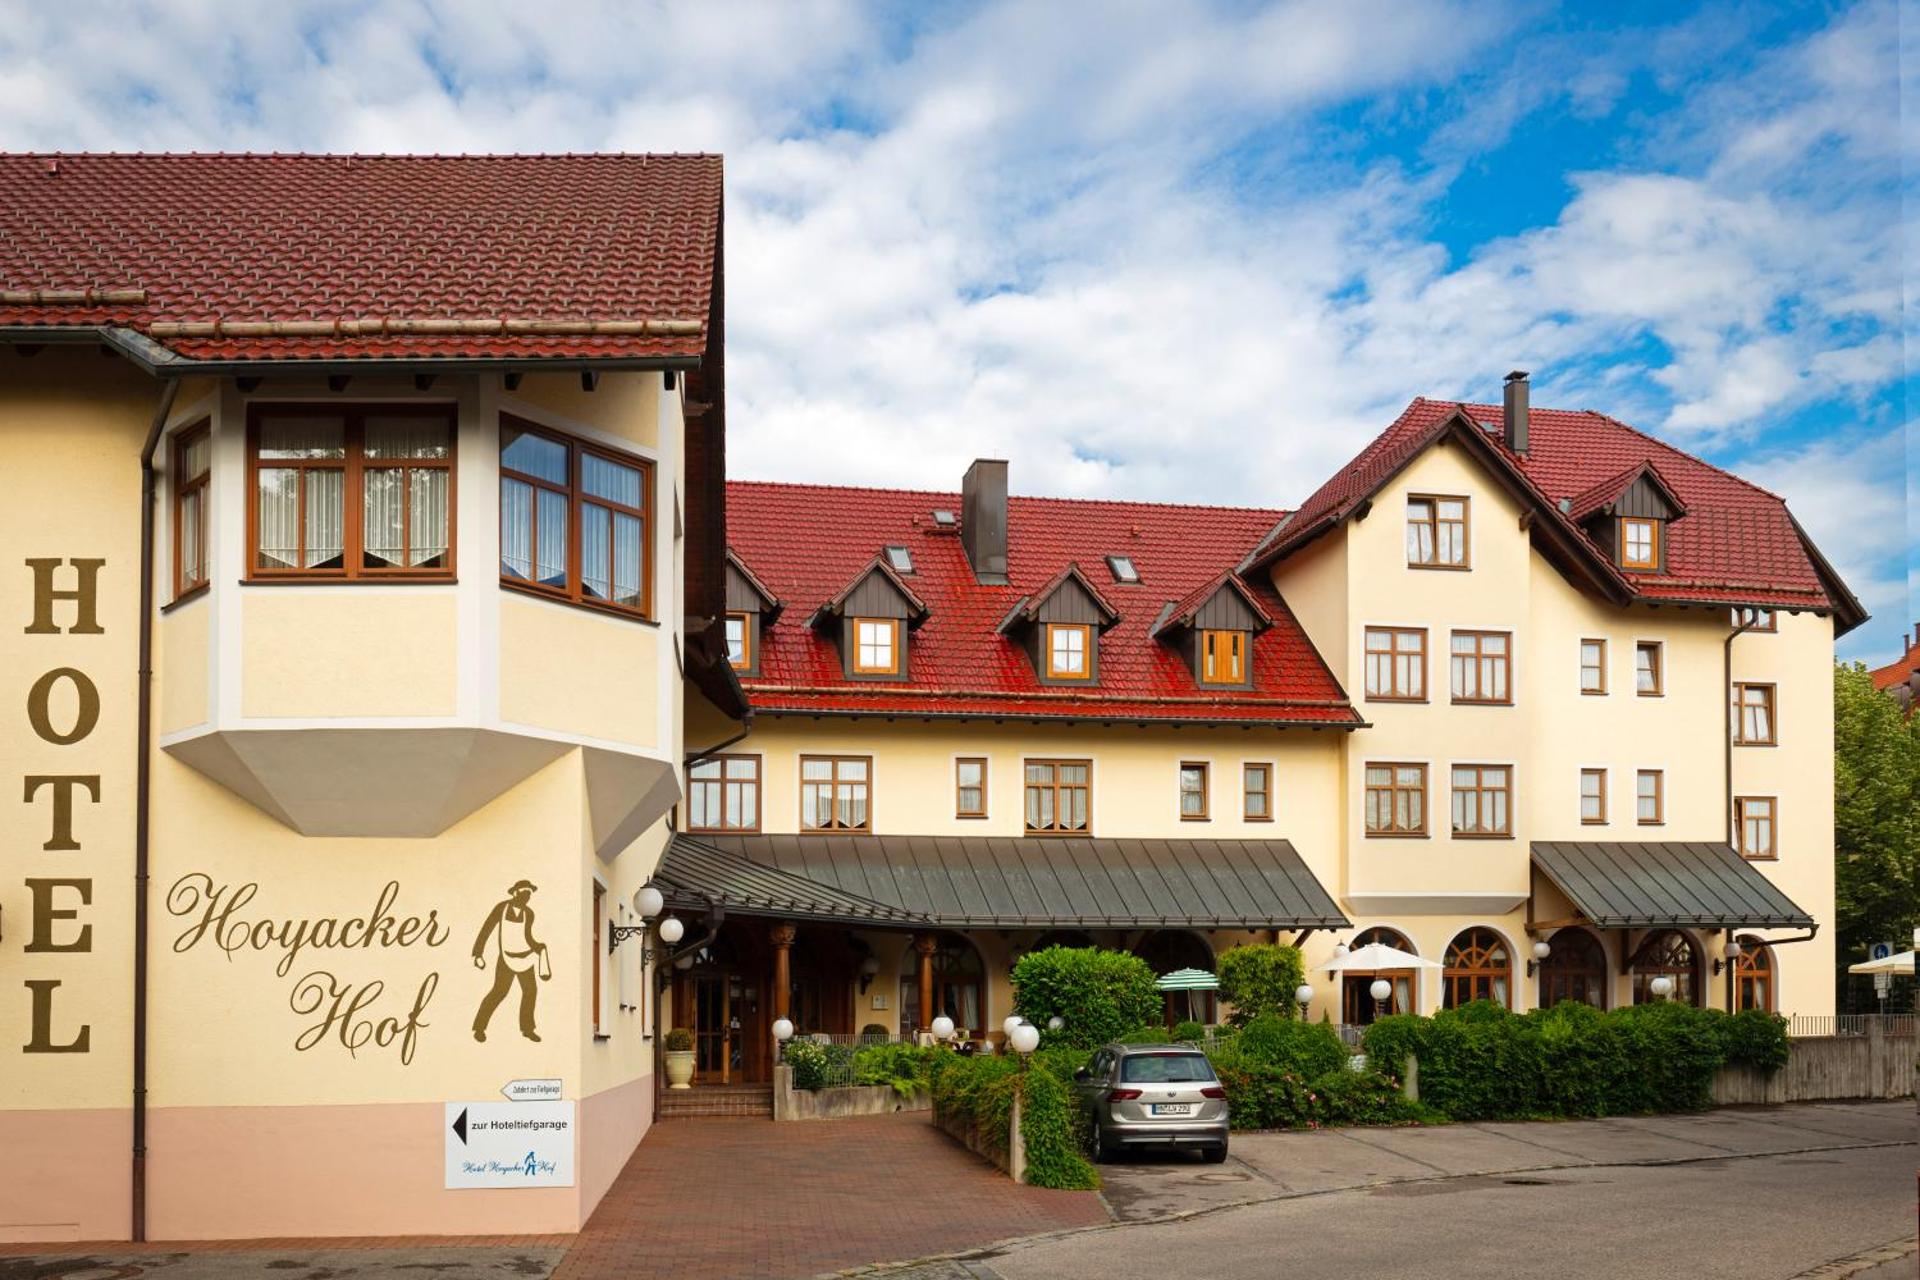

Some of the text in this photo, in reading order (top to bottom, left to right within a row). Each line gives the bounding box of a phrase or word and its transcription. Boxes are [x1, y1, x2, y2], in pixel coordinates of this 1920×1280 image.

[23, 557, 106, 1054] HOTEL
[166, 872, 450, 977] Hoyacker
[289, 970, 440, 1066] Hof
[471, 1120, 568, 1132] zur Hoteltiefgarage
